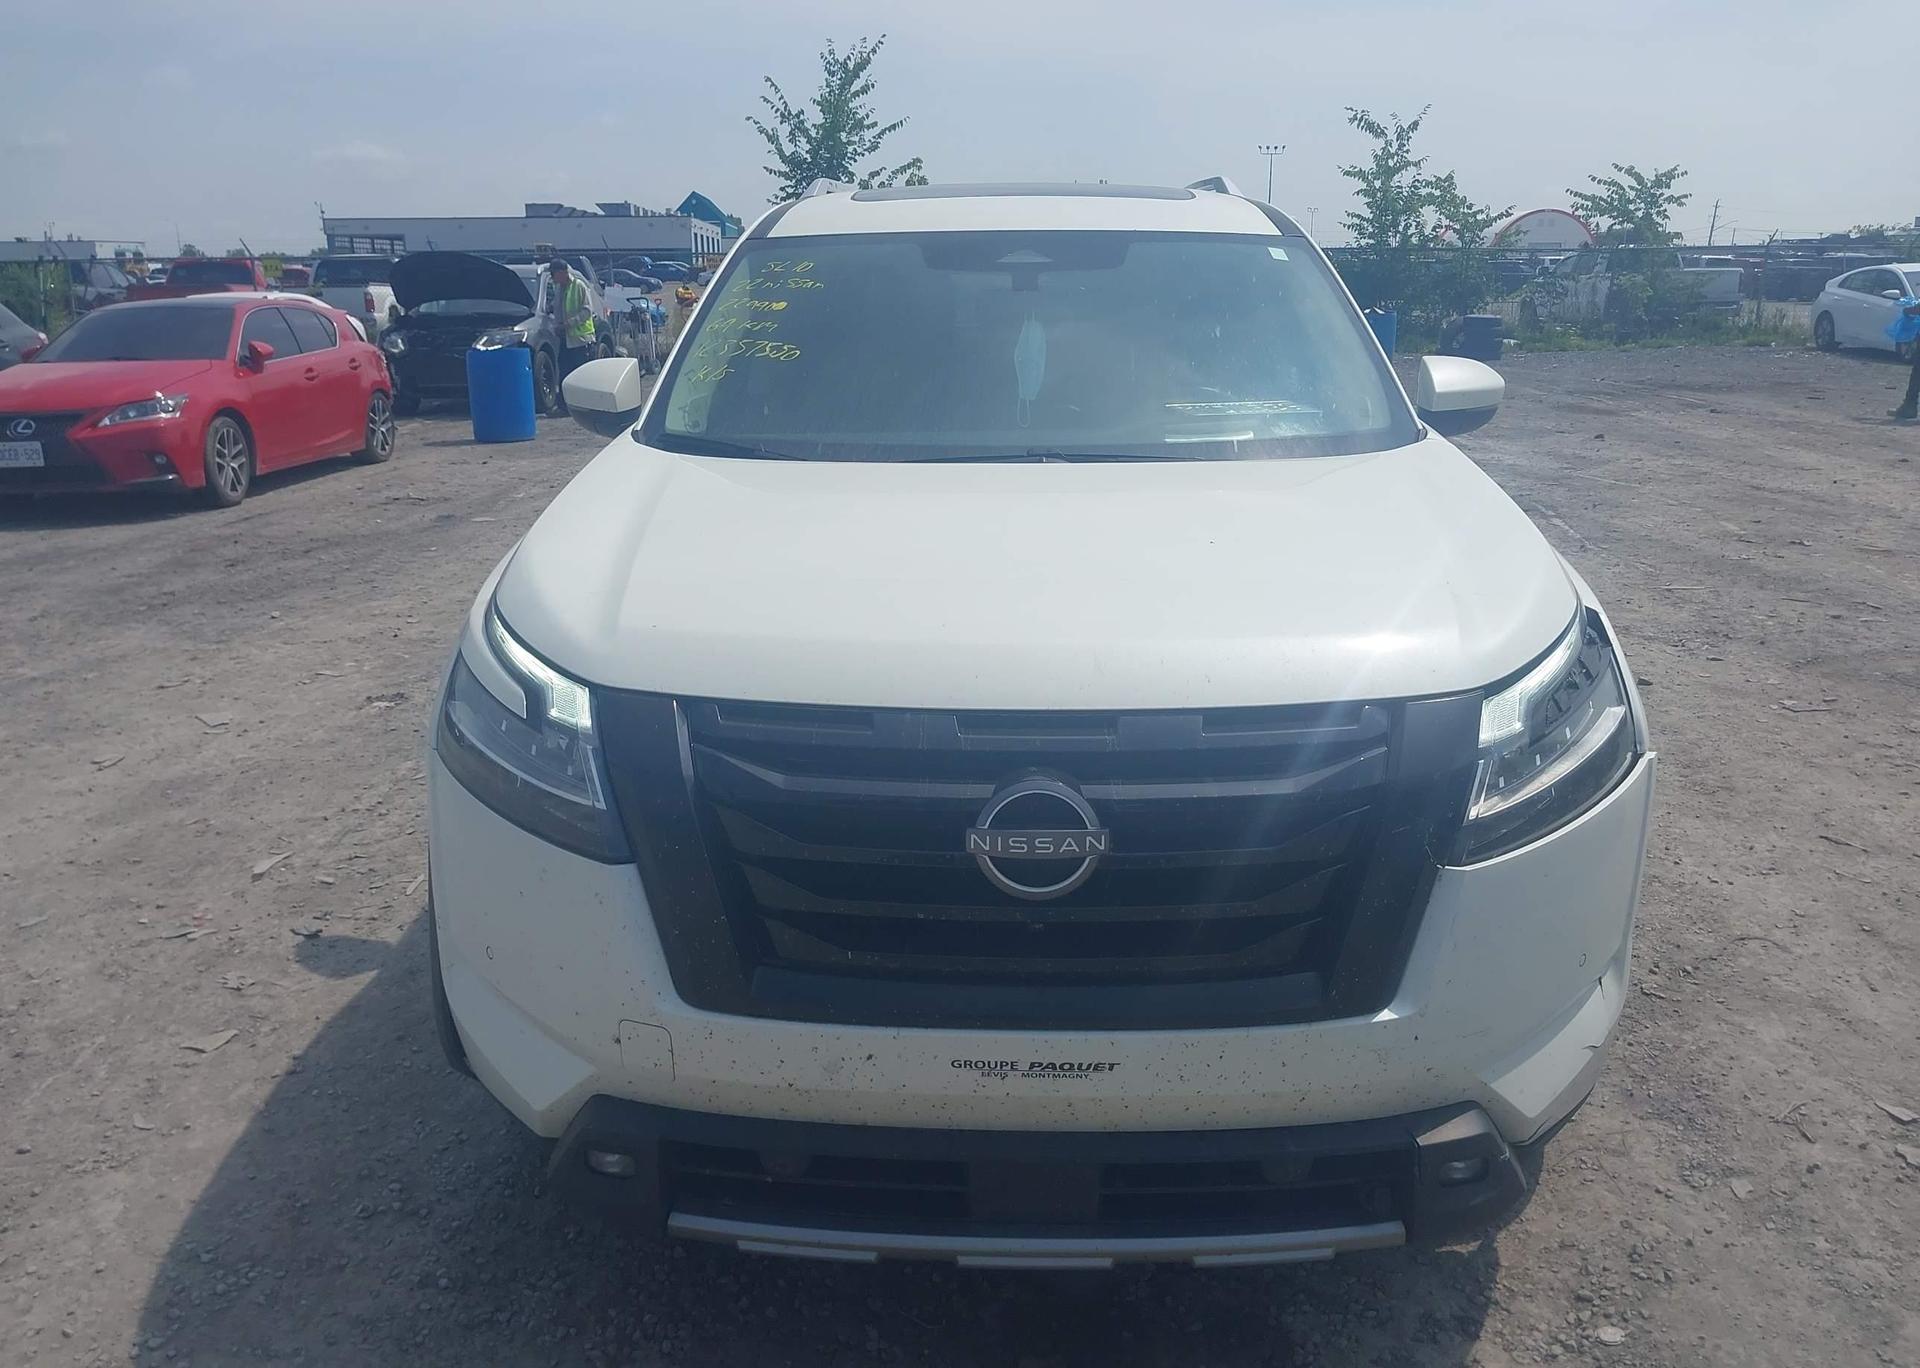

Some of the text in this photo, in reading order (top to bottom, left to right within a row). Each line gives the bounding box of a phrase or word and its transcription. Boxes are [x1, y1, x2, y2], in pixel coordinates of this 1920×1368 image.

[970, 834, 1105, 853] NISSAN
[950, 1059, 1121, 1073] GROUPE PAQUET
[1020, 1071, 1091, 1080] MONTMAGNY
